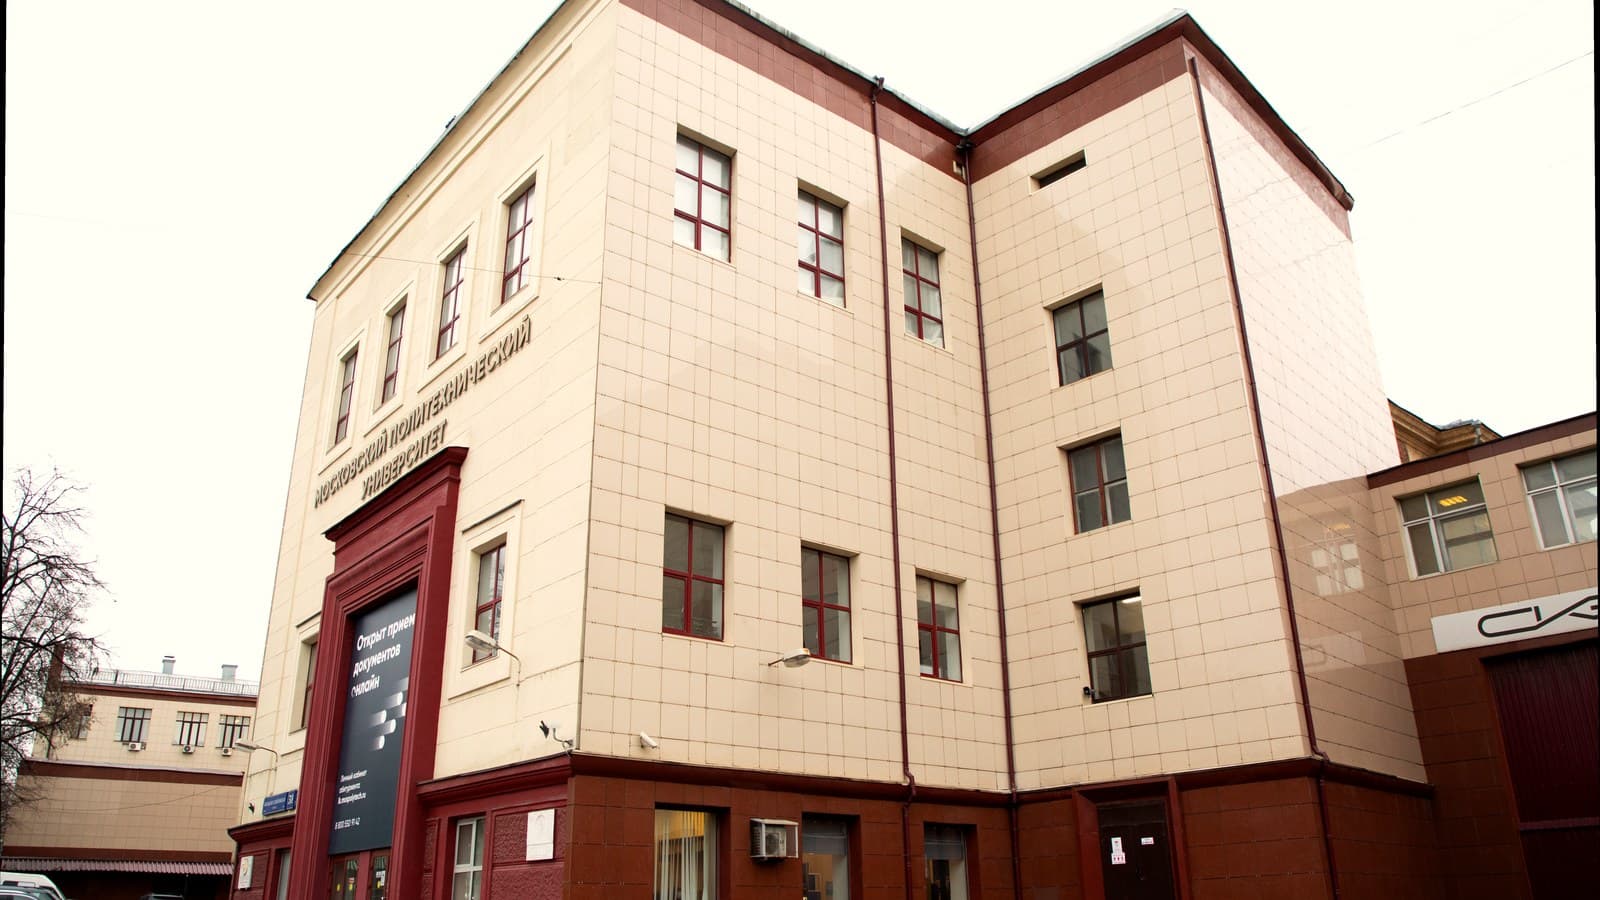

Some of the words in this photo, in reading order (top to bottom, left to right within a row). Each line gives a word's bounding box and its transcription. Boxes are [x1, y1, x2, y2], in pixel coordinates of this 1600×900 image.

[314, 428, 388, 508] МОСКОВСКИЙ
[389, 314, 532, 448] ПОЛИТЕХНИЧЕСКИЙ
[361, 418, 448, 500] УНИВЕРСИТЕТ
[353, 644, 401, 678] документов
[356, 627, 387, 651] Открыт
[387, 613, 416, 639] прием
